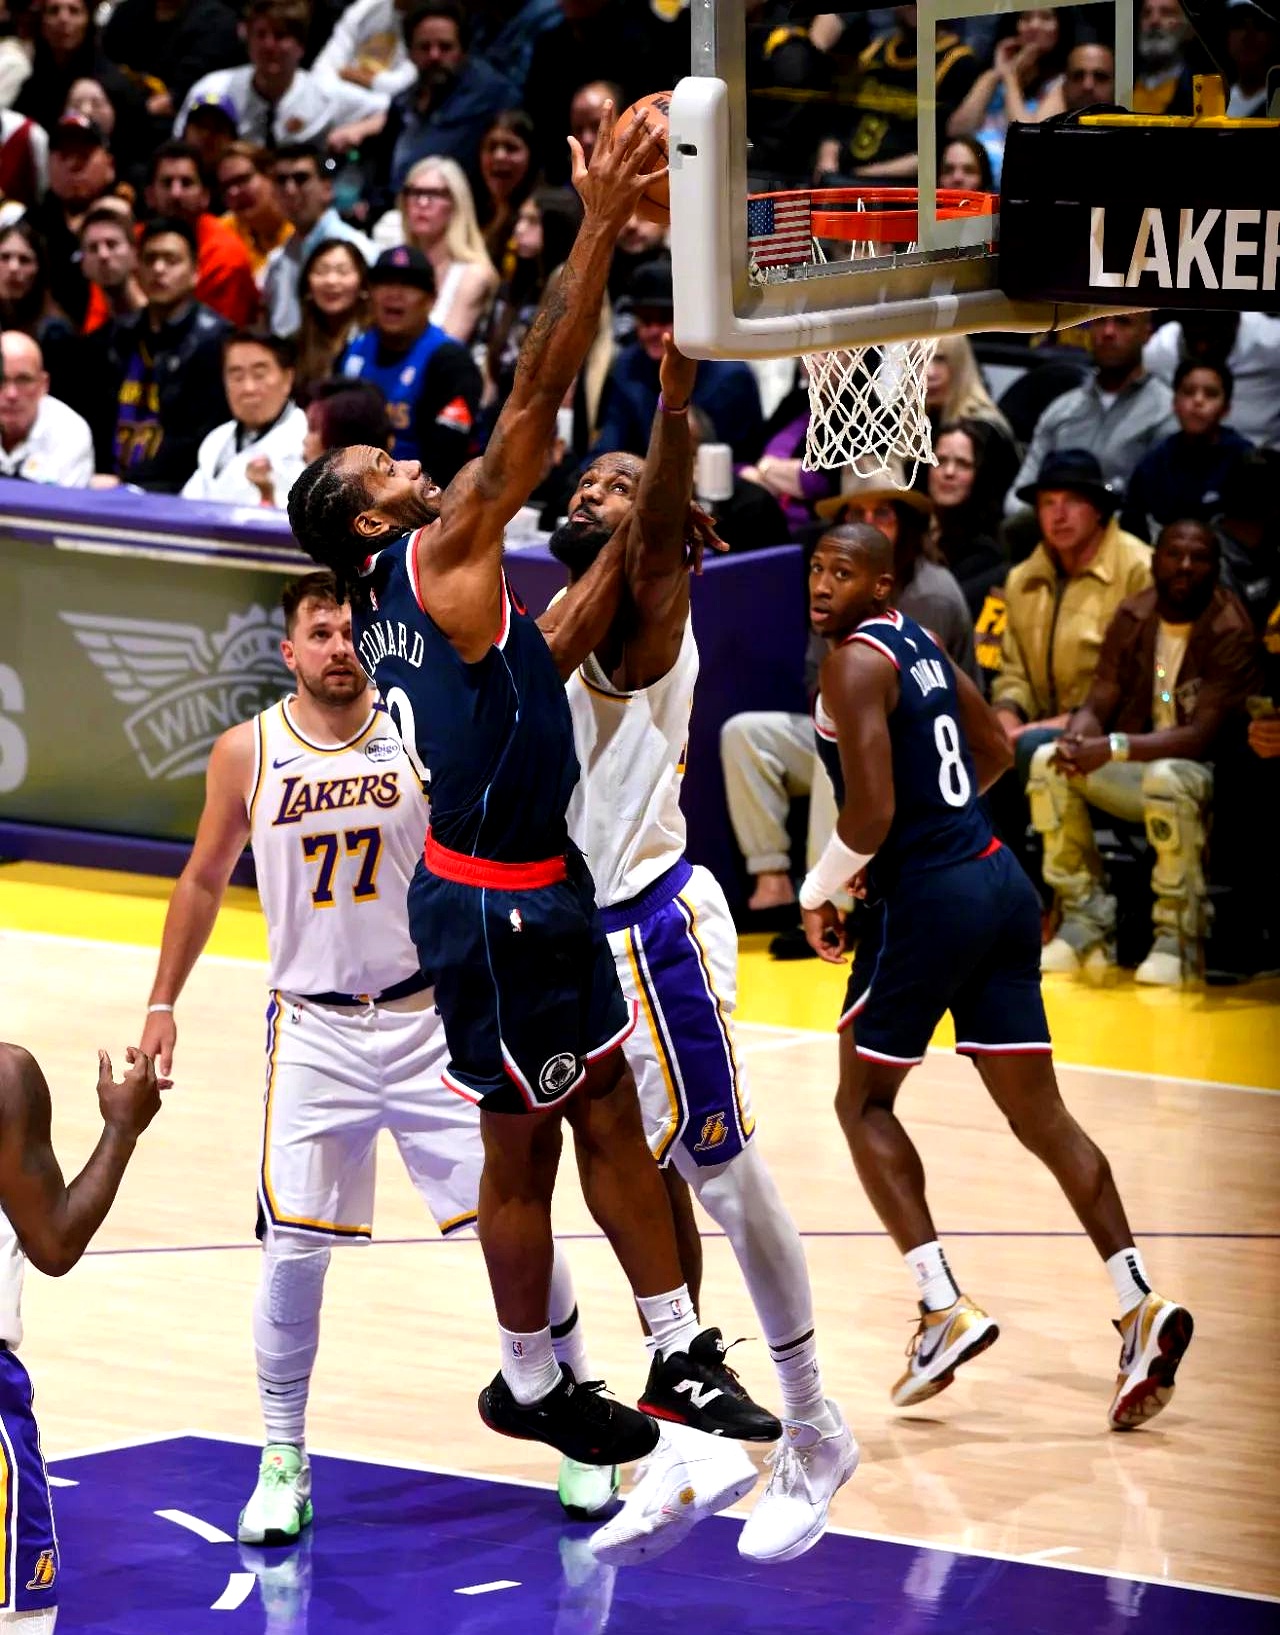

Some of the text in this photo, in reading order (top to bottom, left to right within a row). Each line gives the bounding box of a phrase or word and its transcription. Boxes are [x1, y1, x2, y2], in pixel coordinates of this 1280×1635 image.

[359, 620, 424, 684] EONARD
[145, 685, 274, 752] WING
[933, 714, 971, 807] 8
[272, 772, 400, 826] LAKERS
[302, 824, 384, 909] 77
